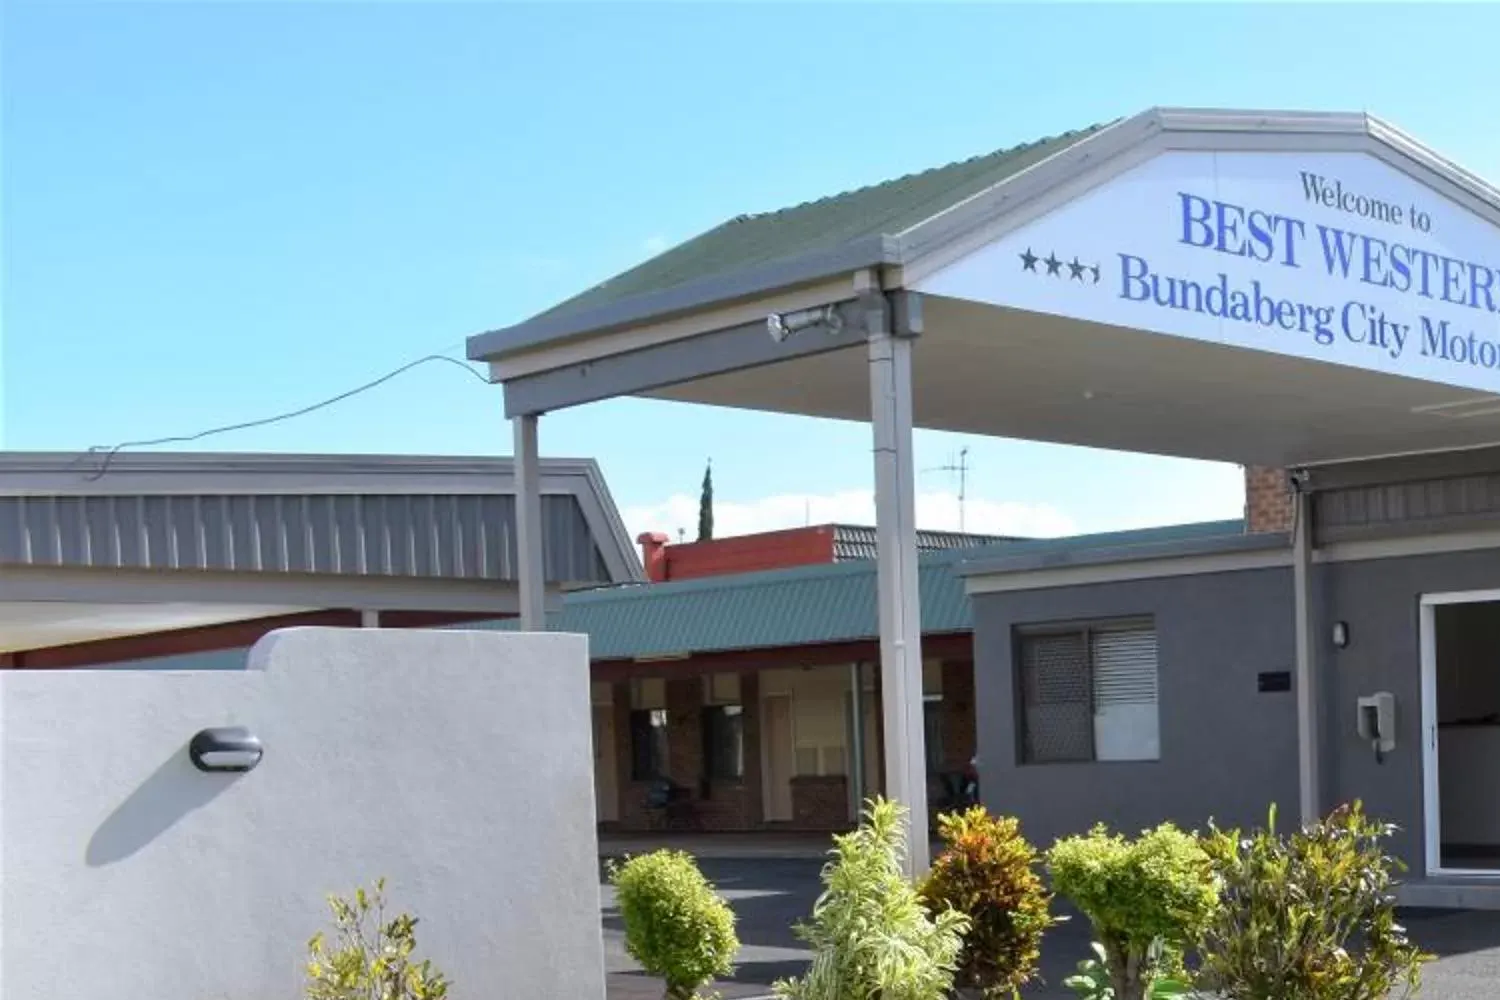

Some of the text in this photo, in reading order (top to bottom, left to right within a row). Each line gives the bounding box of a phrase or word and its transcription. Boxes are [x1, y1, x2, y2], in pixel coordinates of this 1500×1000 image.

[1177, 191, 1306, 268] BEST
[1300, 171, 1432, 233] Welcome to
[1118, 252, 1335, 345] Bundaberg
[1341, 301, 1411, 359] City
